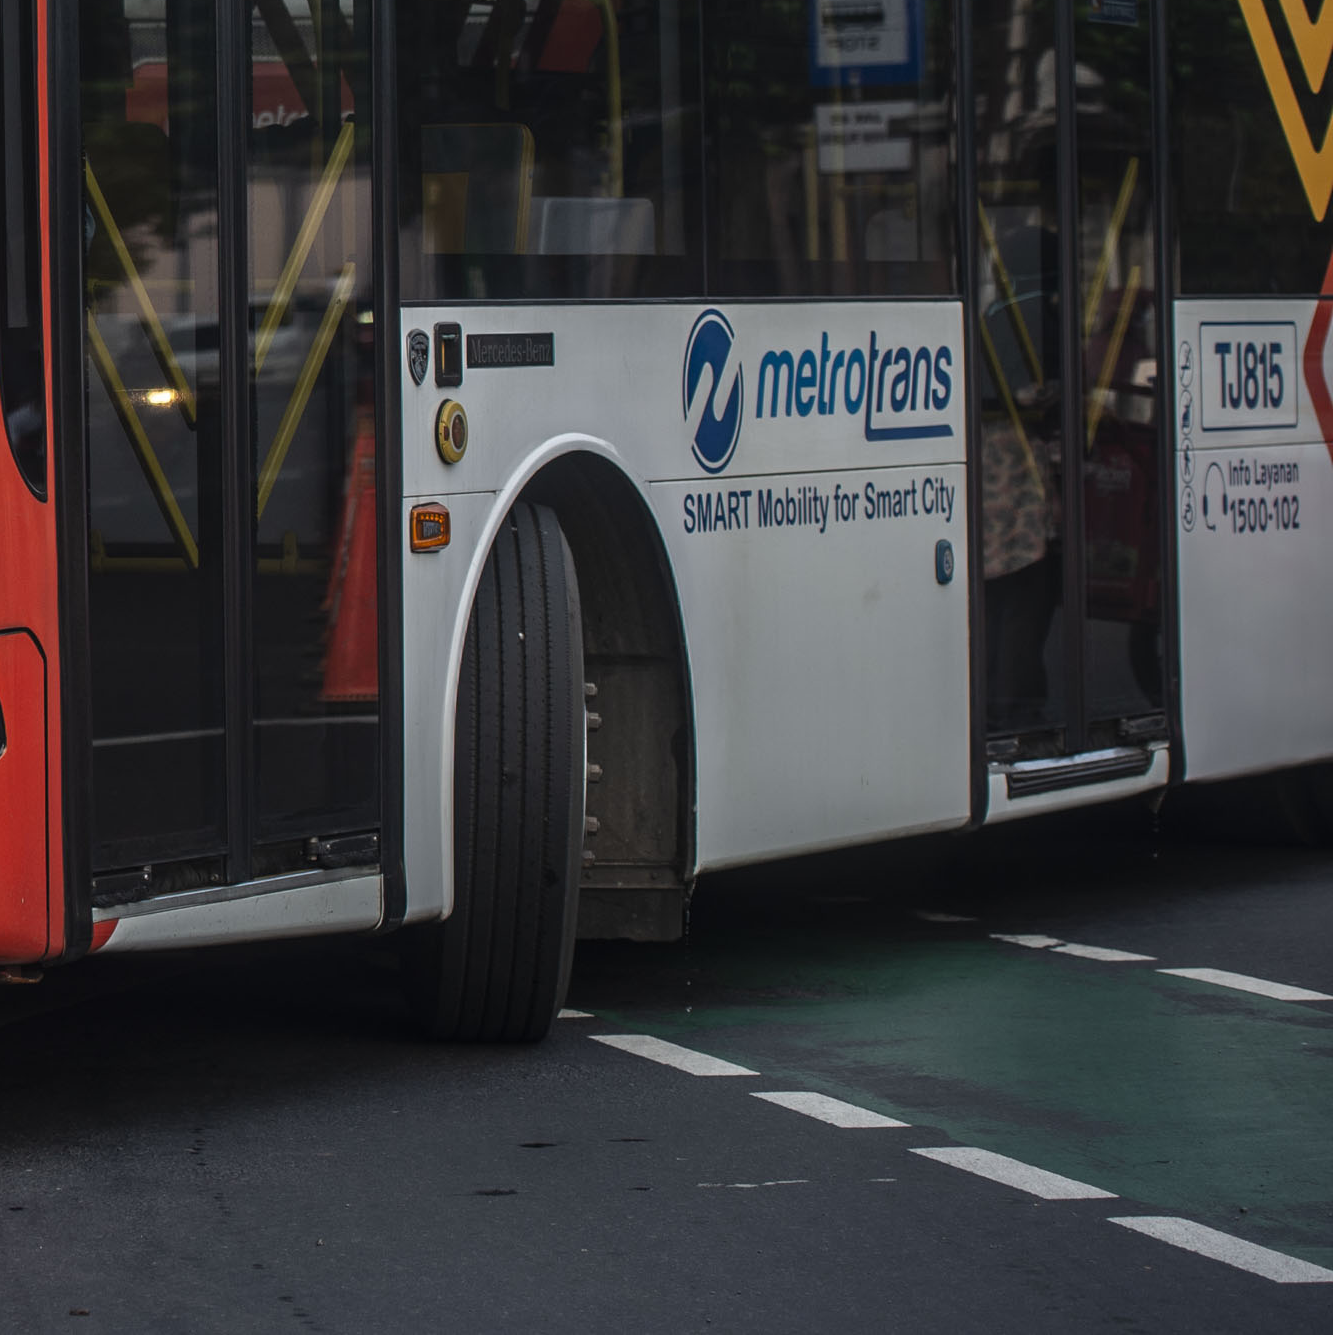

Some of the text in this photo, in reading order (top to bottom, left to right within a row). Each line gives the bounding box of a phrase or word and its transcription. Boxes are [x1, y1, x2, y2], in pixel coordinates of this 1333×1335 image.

[471, 336, 552, 364] Mercedes-Benz
[755, 330, 954, 441] metrotrans
[1214, 341, 1284, 410] TJ815
[1229, 458, 1299, 491] Info Layanan
[683, 477, 955, 534] SMART Mobility for Smart City
[1229, 495, 1300, 534] 1500-102
